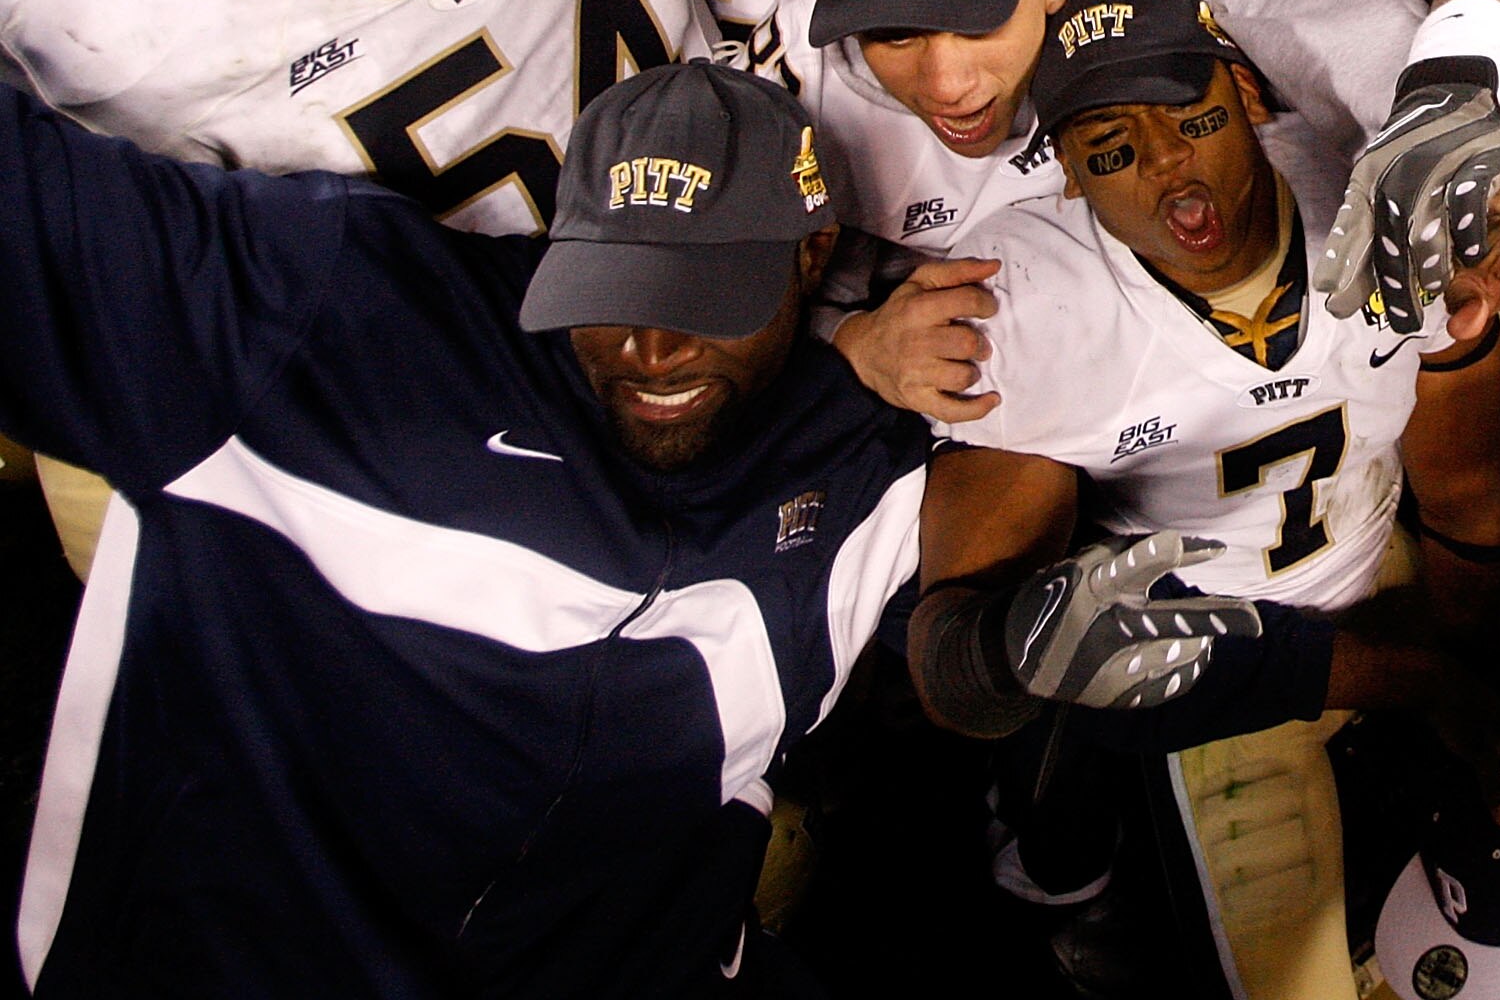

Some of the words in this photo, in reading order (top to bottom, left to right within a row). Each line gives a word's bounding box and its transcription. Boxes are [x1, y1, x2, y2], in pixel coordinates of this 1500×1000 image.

[1057, 3, 1134, 58] PITT
[290, 38, 339, 75] BIG
[290, 38, 359, 88] EAST
[1096, 150, 1124, 174] NO
[608, 156, 712, 213] PITT
[902, 209, 958, 233] EAST
[905, 198, 943, 219] BIG
[1249, 378, 1309, 405] PITT
[1113, 424, 1177, 456] EAST
[1118, 416, 1161, 444] BIG
[1216, 402, 1350, 577] 7
[776, 490, 826, 544] PITT
